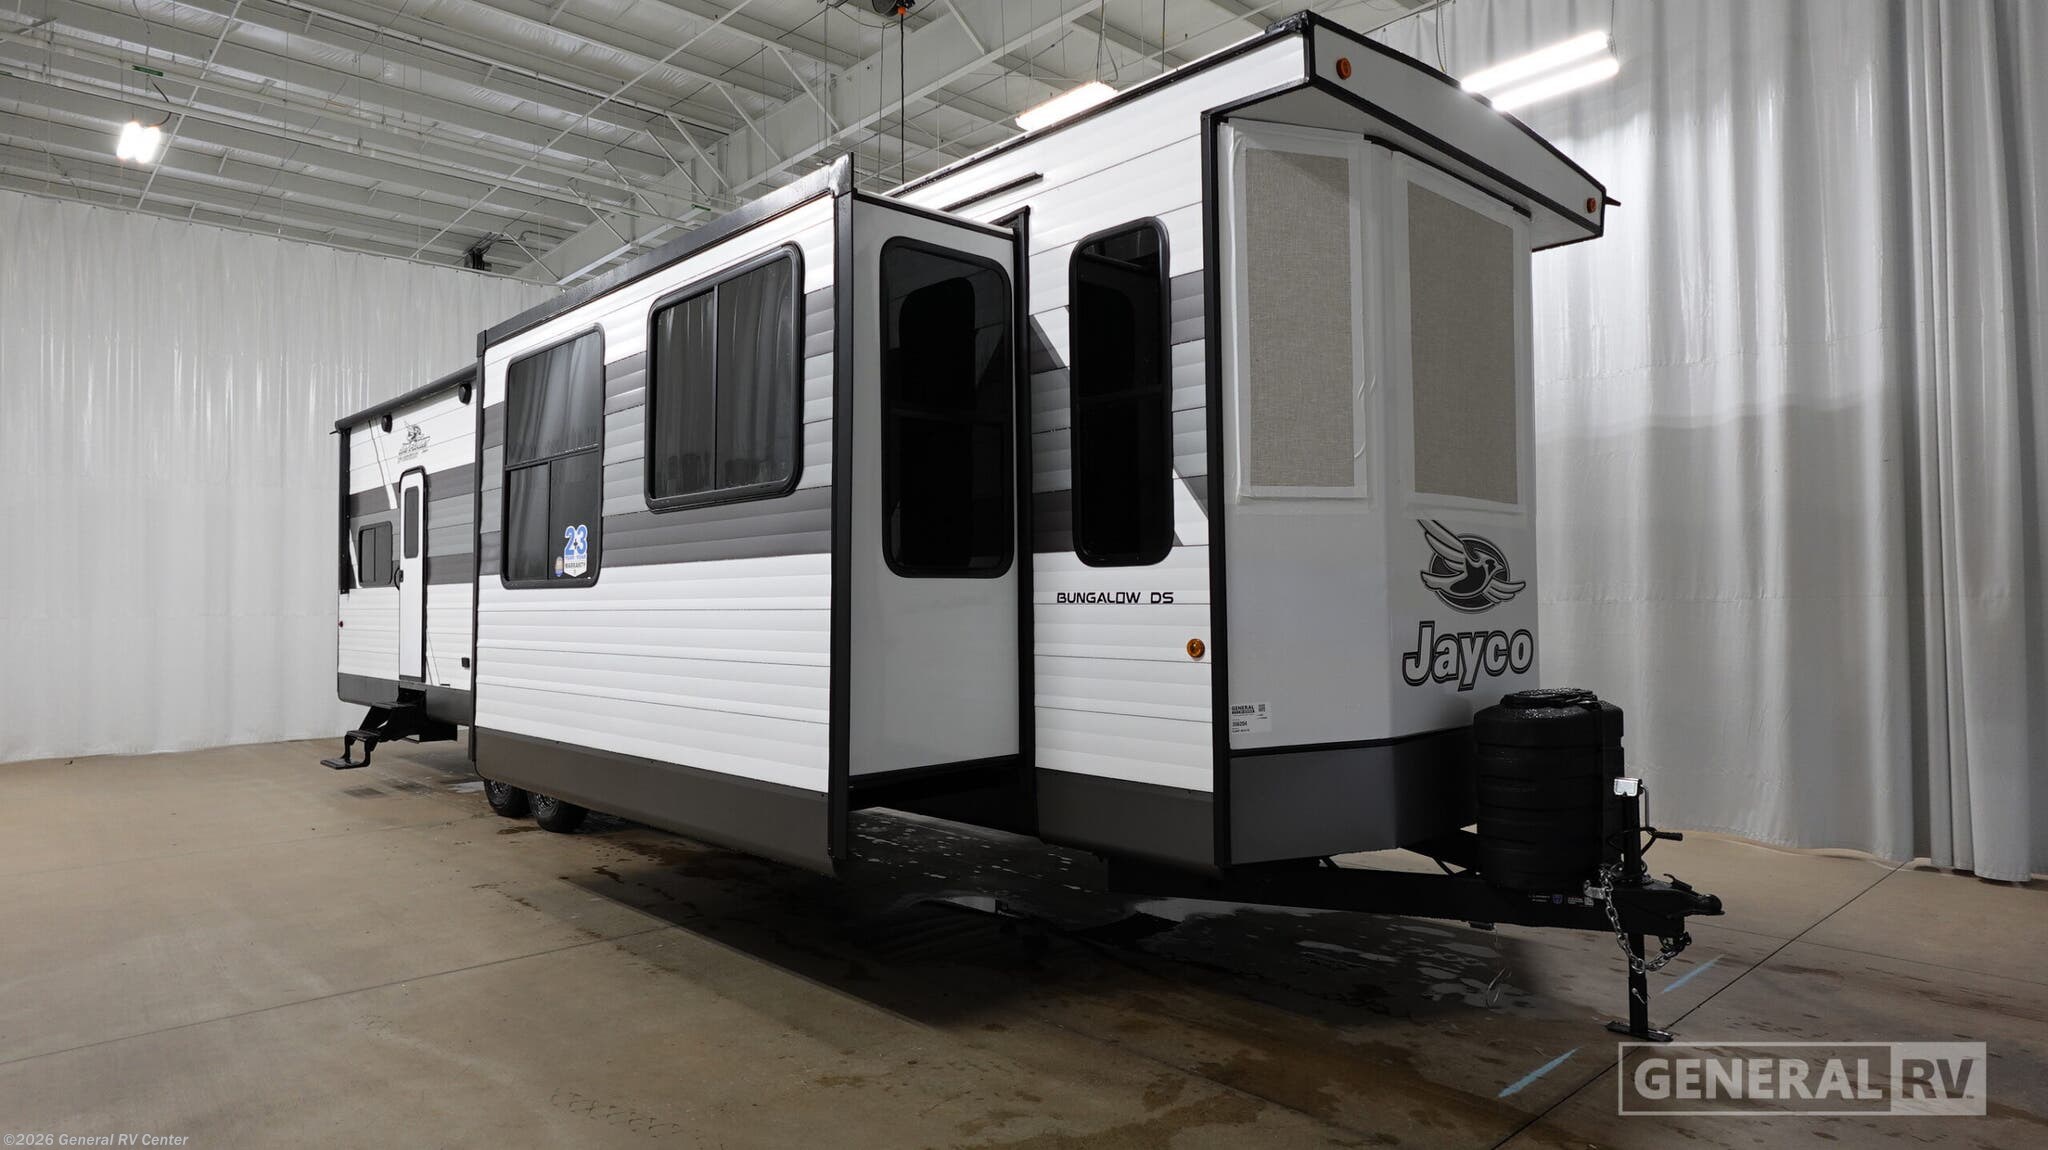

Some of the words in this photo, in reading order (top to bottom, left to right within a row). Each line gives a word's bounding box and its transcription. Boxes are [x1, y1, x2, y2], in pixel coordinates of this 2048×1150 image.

[1056, 591, 1141, 604] BUNGALOW
[1150, 591, 1174, 604] DS
[1402, 620, 1534, 692] Jayco
